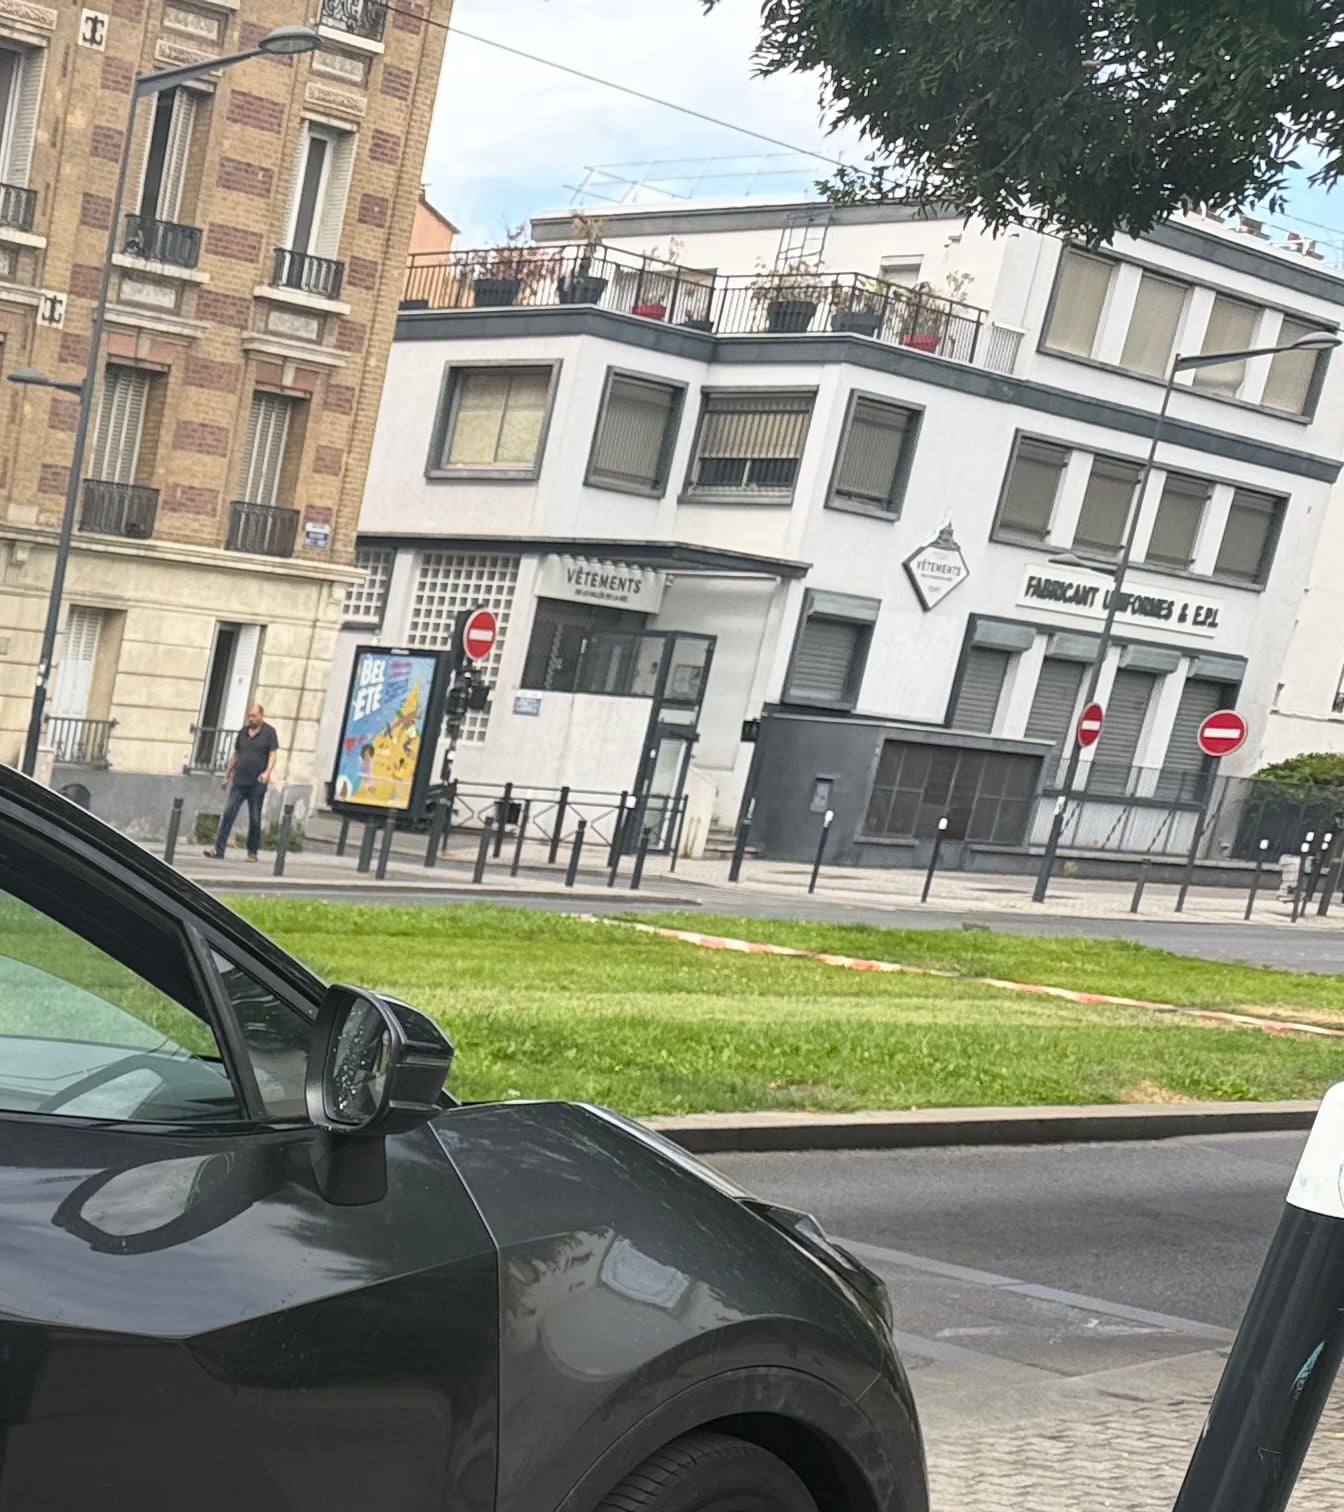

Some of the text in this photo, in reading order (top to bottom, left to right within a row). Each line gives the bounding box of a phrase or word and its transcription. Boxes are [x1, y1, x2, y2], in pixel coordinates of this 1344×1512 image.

[567, 566, 643, 595] VÊTEMENTS
[1024, 576, 1100, 608] FABRICANT
[1177, 603, 1189, 623] &
